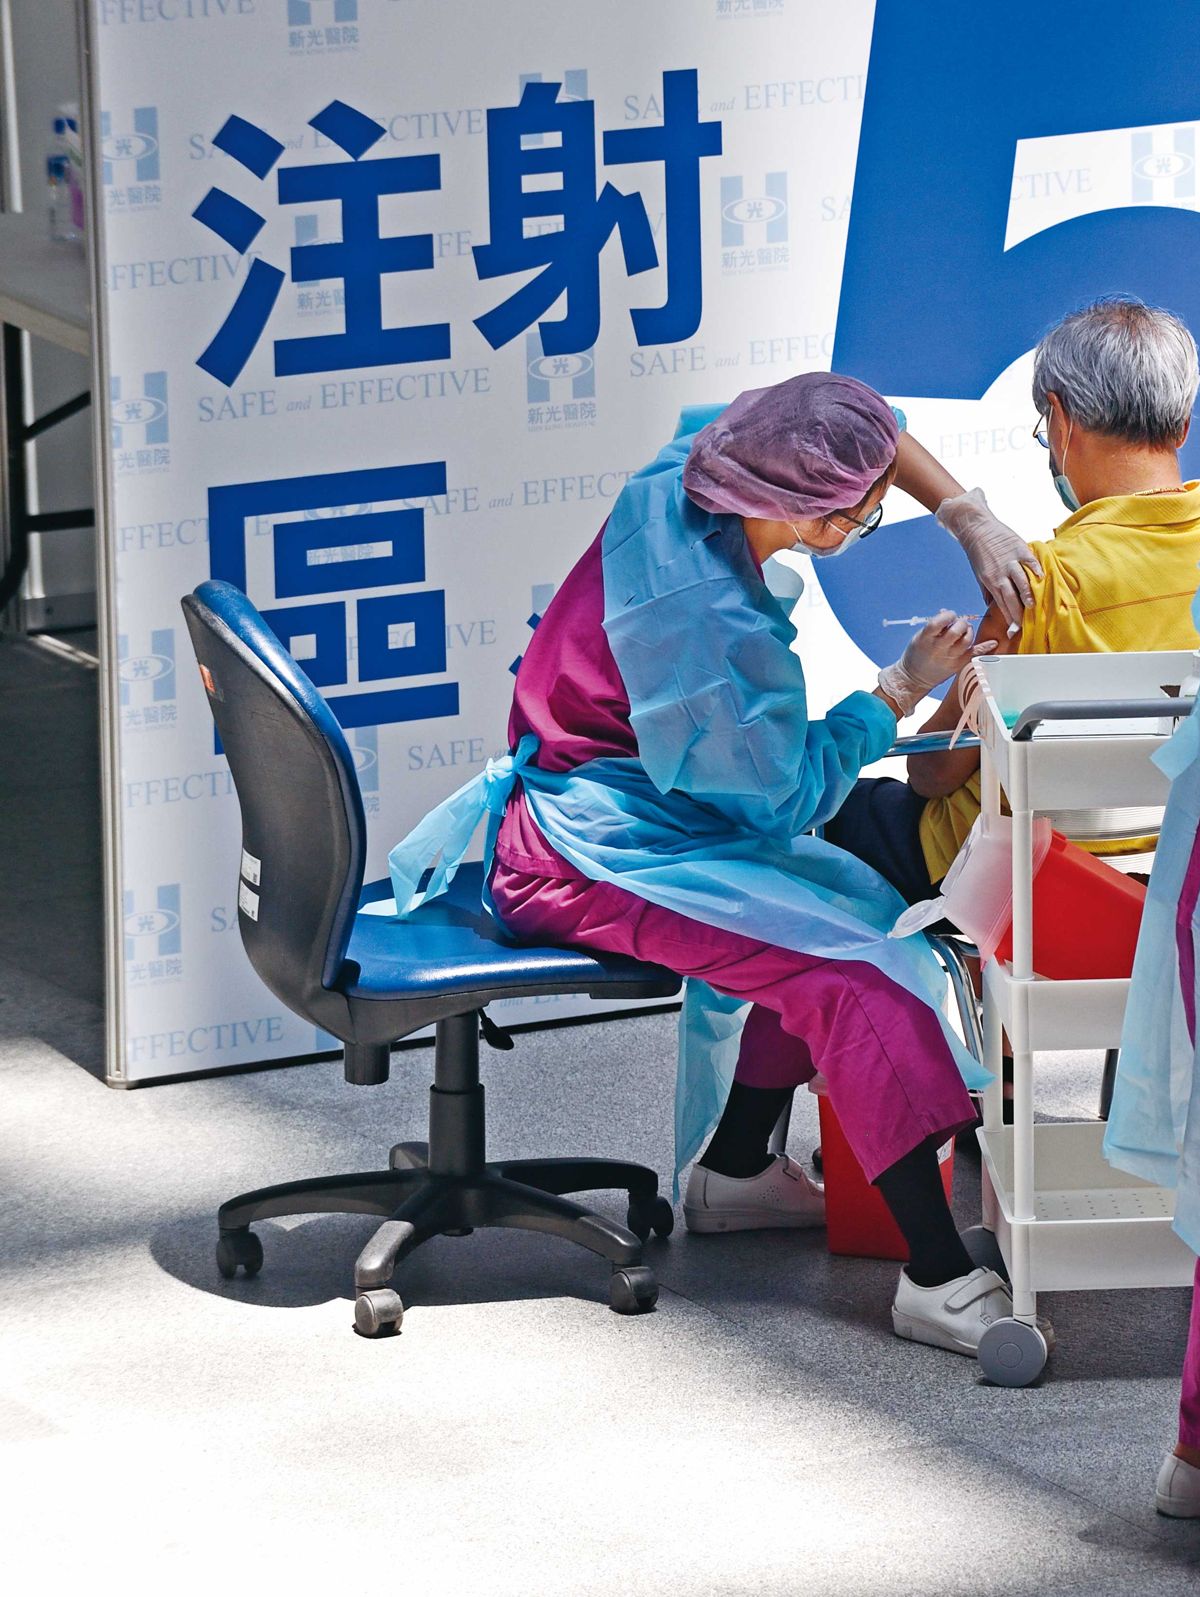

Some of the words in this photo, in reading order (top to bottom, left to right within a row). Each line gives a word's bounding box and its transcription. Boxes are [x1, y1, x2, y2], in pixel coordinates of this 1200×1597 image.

[711, 97, 737, 113] and
[743, 74, 866, 111] EFFECTI
[190, 67, 723, 389] 注射
[629, 345, 707, 379] SAFE
[714, 351, 741, 368] and
[200, 388, 279, 423] SAFE
[285, 394, 312, 412] and
[320, 367, 492, 410] EFFECTIVE
[488, 490, 515, 509] and
[408, 737, 486, 771] SAFE
